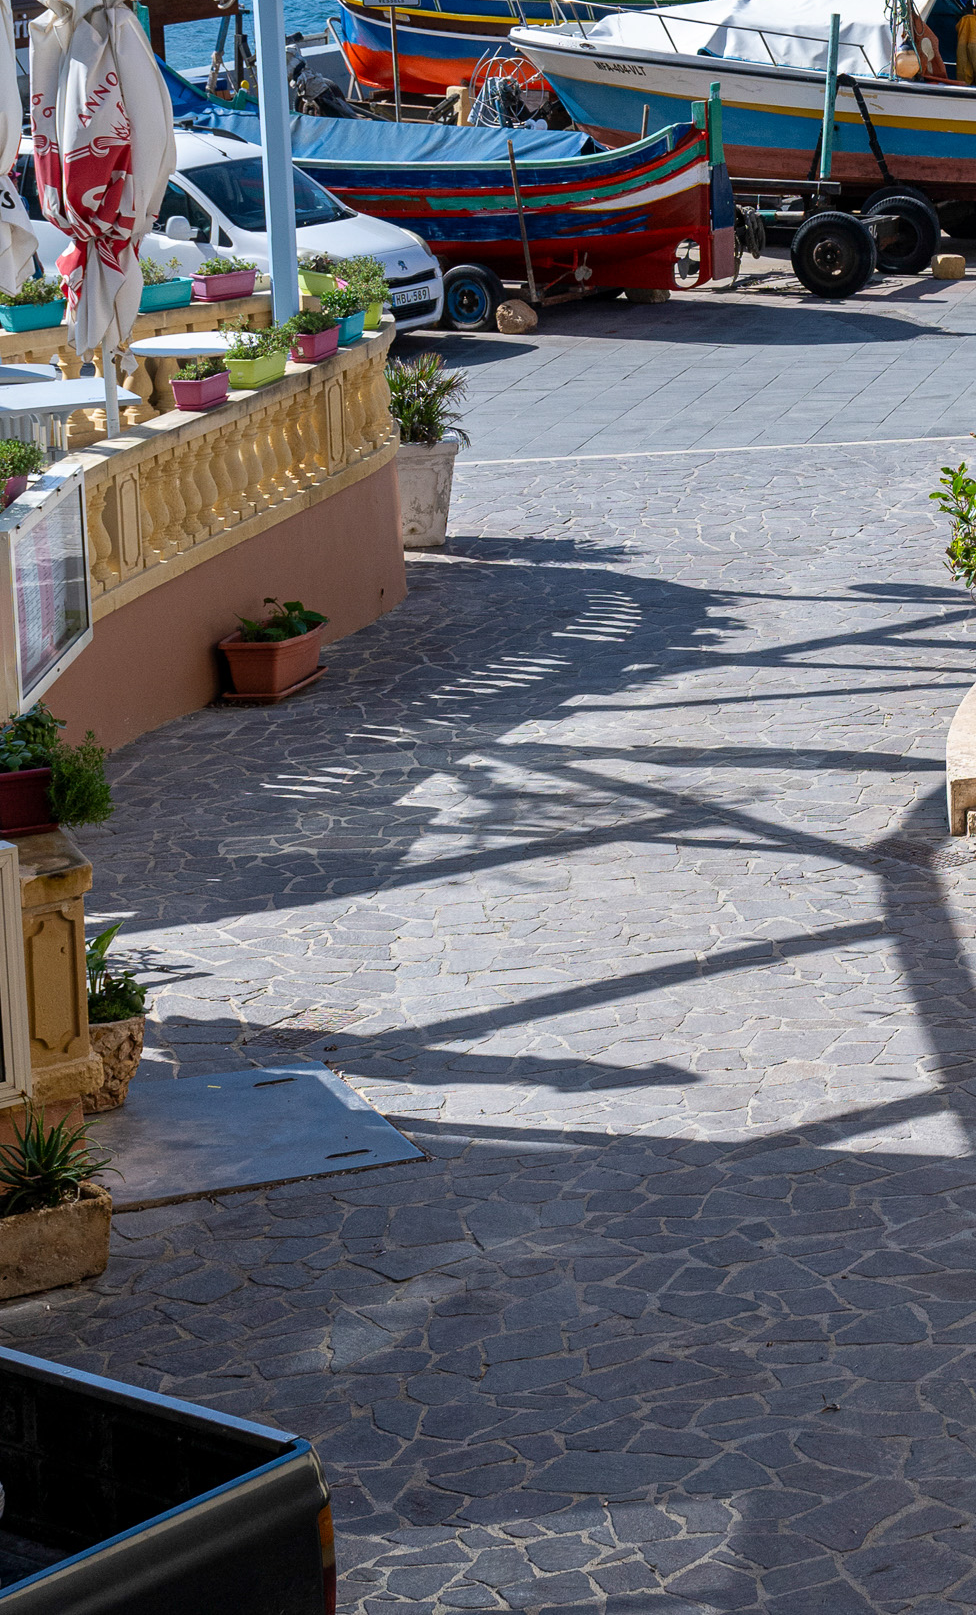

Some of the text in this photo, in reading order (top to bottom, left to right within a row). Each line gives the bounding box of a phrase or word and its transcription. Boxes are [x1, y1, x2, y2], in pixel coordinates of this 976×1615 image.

[77, 71, 119, 128] ANNO
[396, 289, 427, 305] HBL 589
